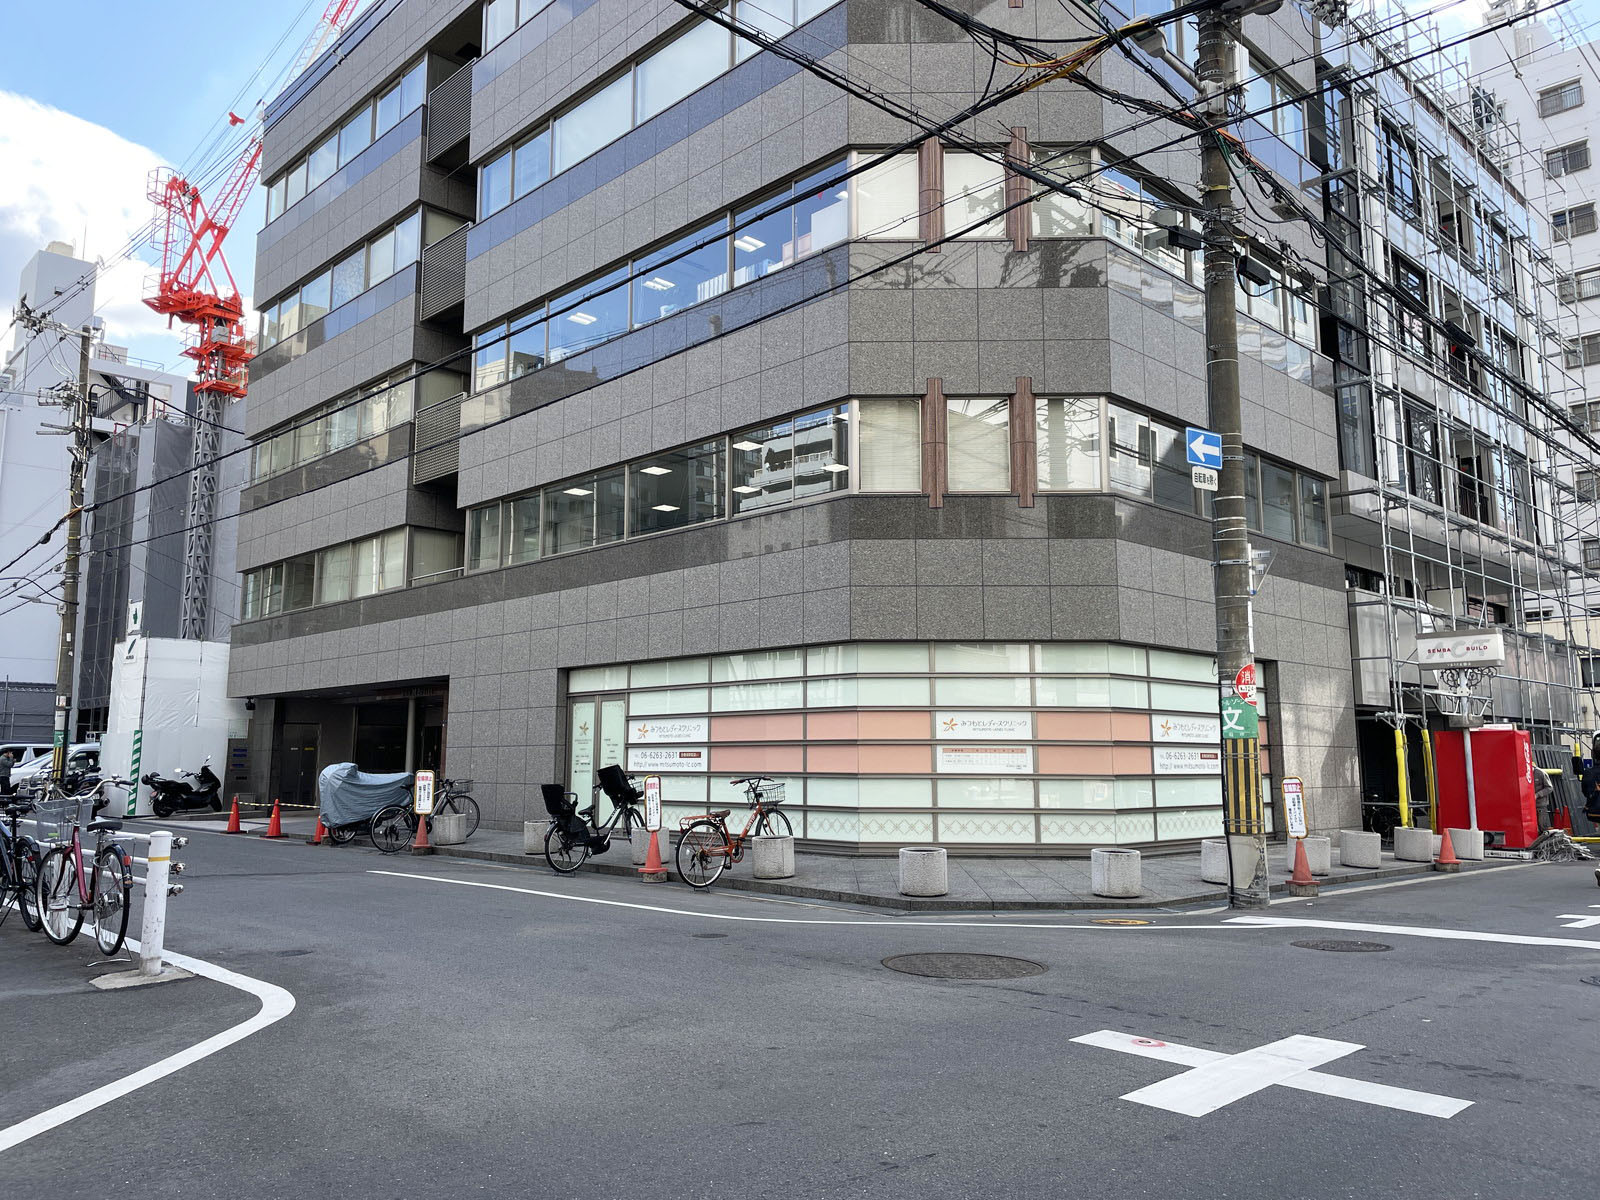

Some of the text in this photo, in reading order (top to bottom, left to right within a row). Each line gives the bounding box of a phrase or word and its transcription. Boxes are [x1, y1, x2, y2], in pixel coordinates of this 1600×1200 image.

[1222, 706, 1245, 731] 文
[960, 719, 1027, 728] みつもとレディースクリニック
[641, 751, 678, 759] 06-6263-2631
[1166, 751, 1199, 760] 06-6263-2631
